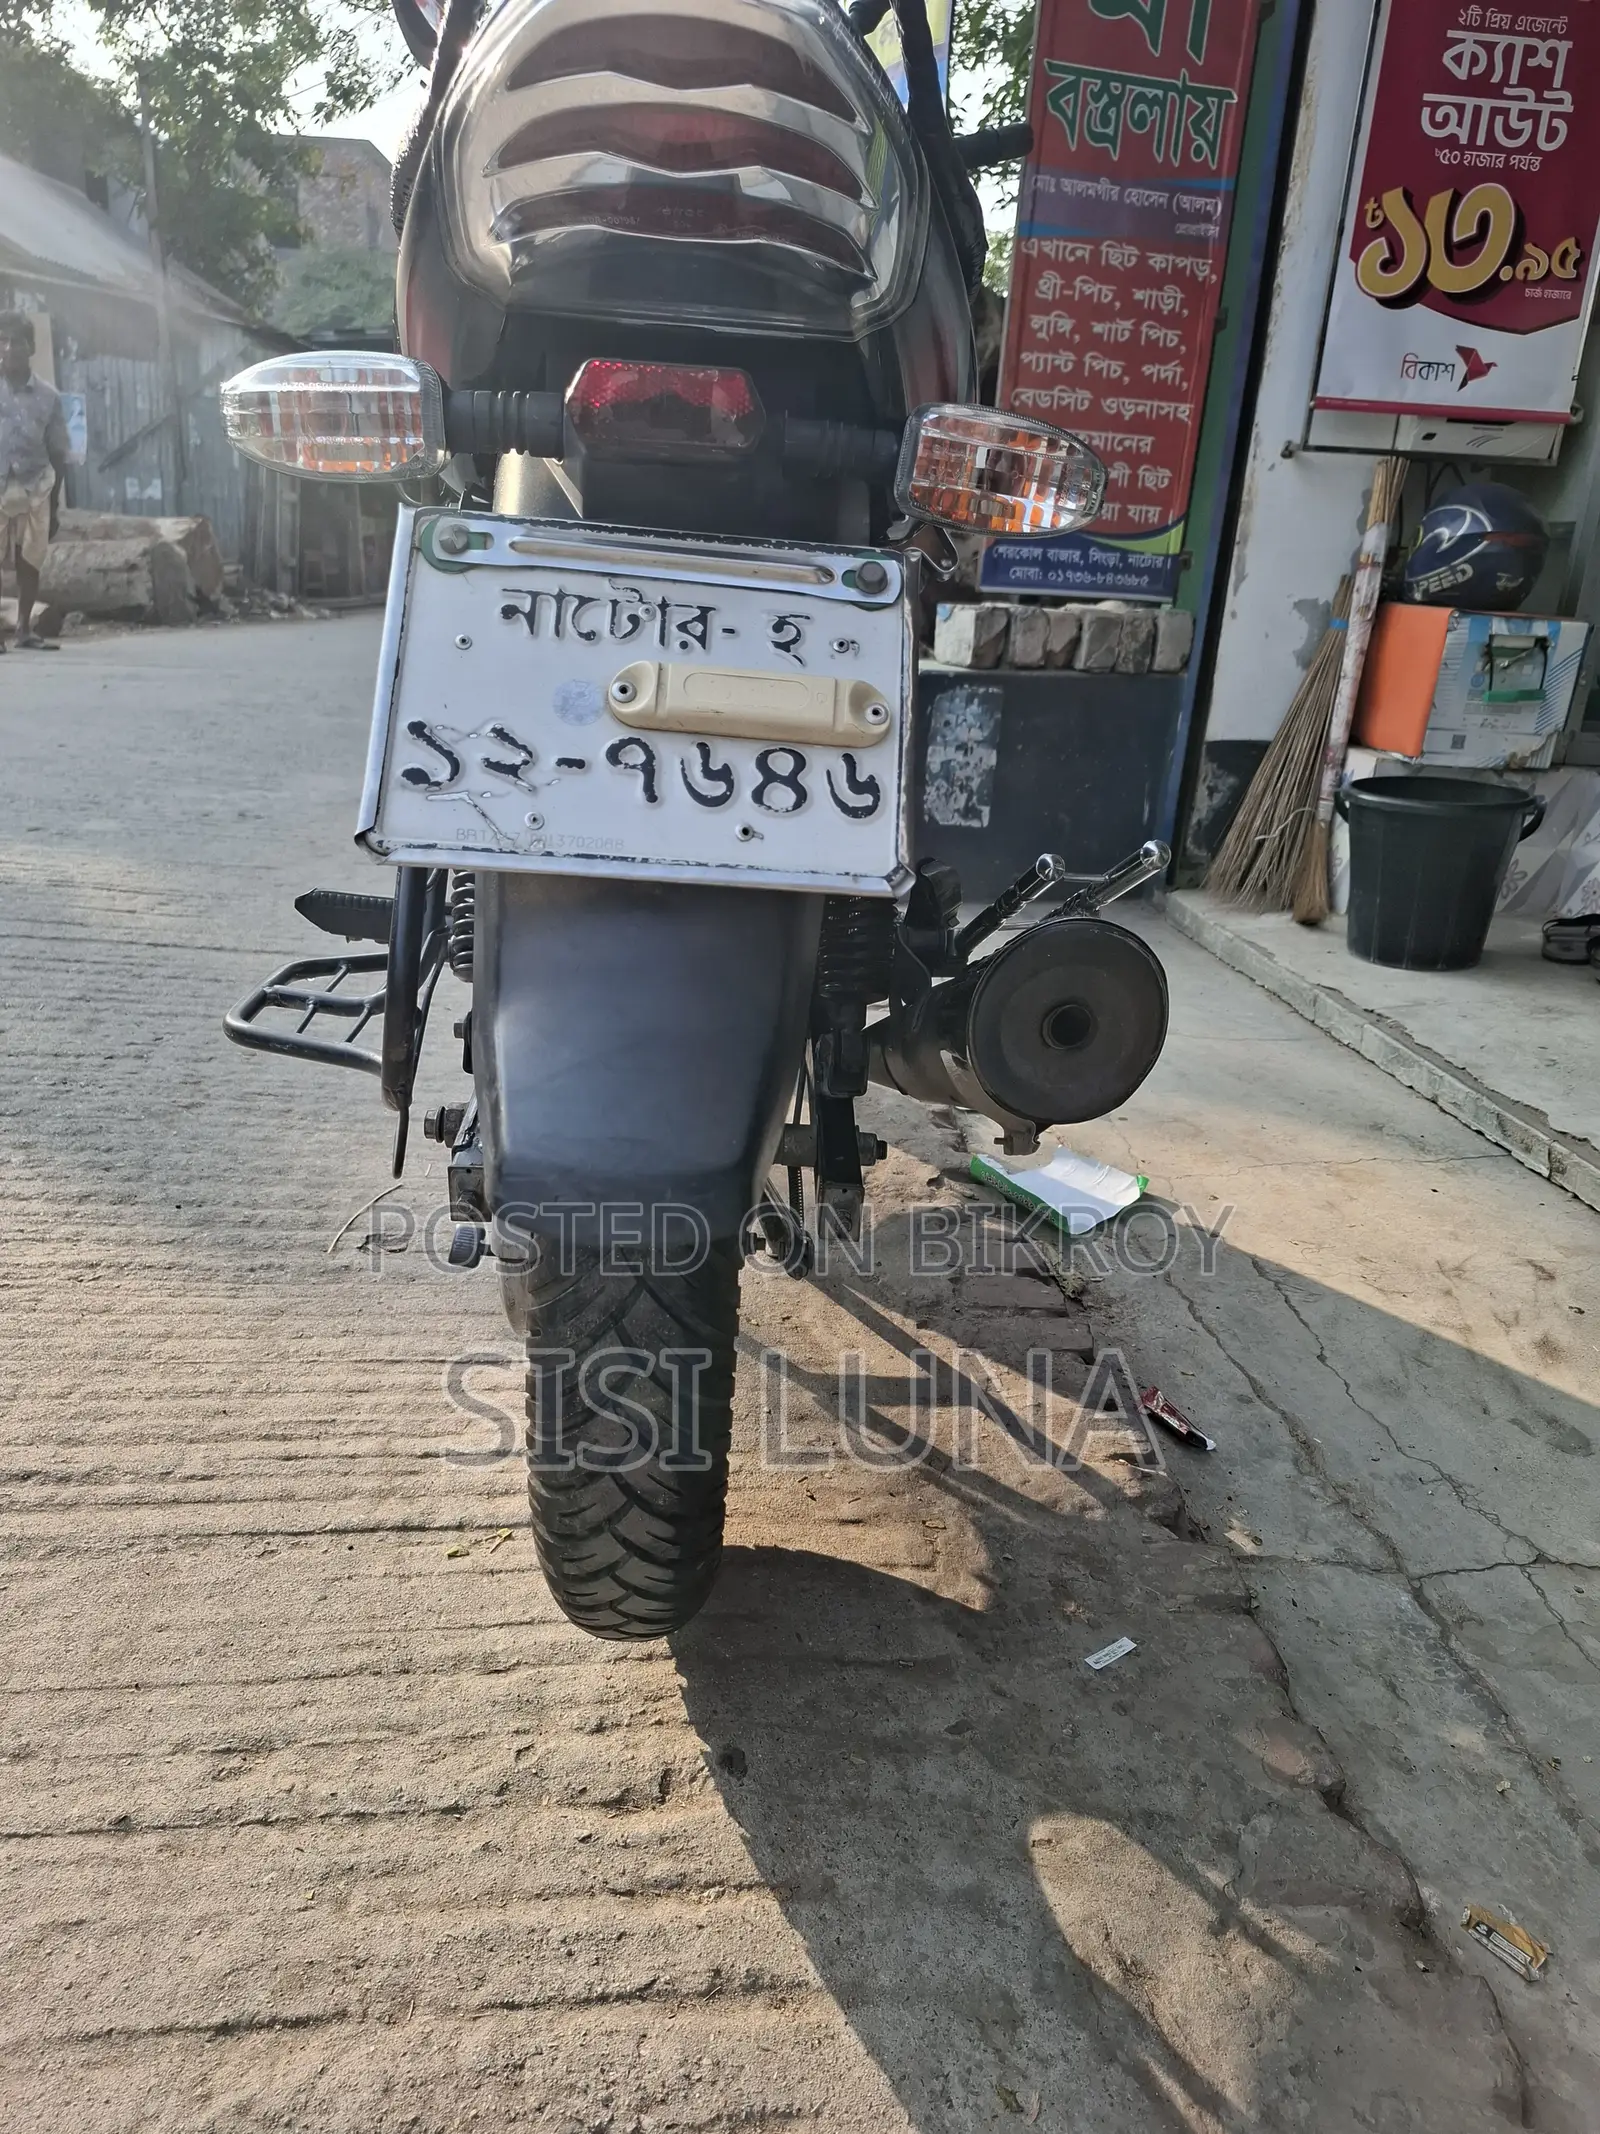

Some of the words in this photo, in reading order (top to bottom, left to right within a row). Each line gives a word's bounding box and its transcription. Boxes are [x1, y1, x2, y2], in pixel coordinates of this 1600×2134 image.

[1458, 5, 1482, 28] ২টি
[1485, 8, 1511, 31] প্রিয়
[1514, 14, 1568, 35] এজেন্টে
[1442, 30, 1573, 88] ক্যাশ
[1420, 88, 1574, 152] আউট
[1463, 150, 1506, 169] হাজার
[1509, 152, 1543, 172] পর্যন্ত
[1020, 237, 1094, 265] এখানে
[1100, 240, 1141, 270] ছিট
[1147, 251, 1218, 284] কাপড়,
[1091, 319, 1135, 345] শার্ট
[1020, 350, 1077, 374] প্যান্ট
[1140, 362, 1190, 391] পর্দা,
[1400, 353, 1455, 383] বিকাশ
[1137, 464, 1173, 493] ছিট
[766, 612, 811, 667] হ
